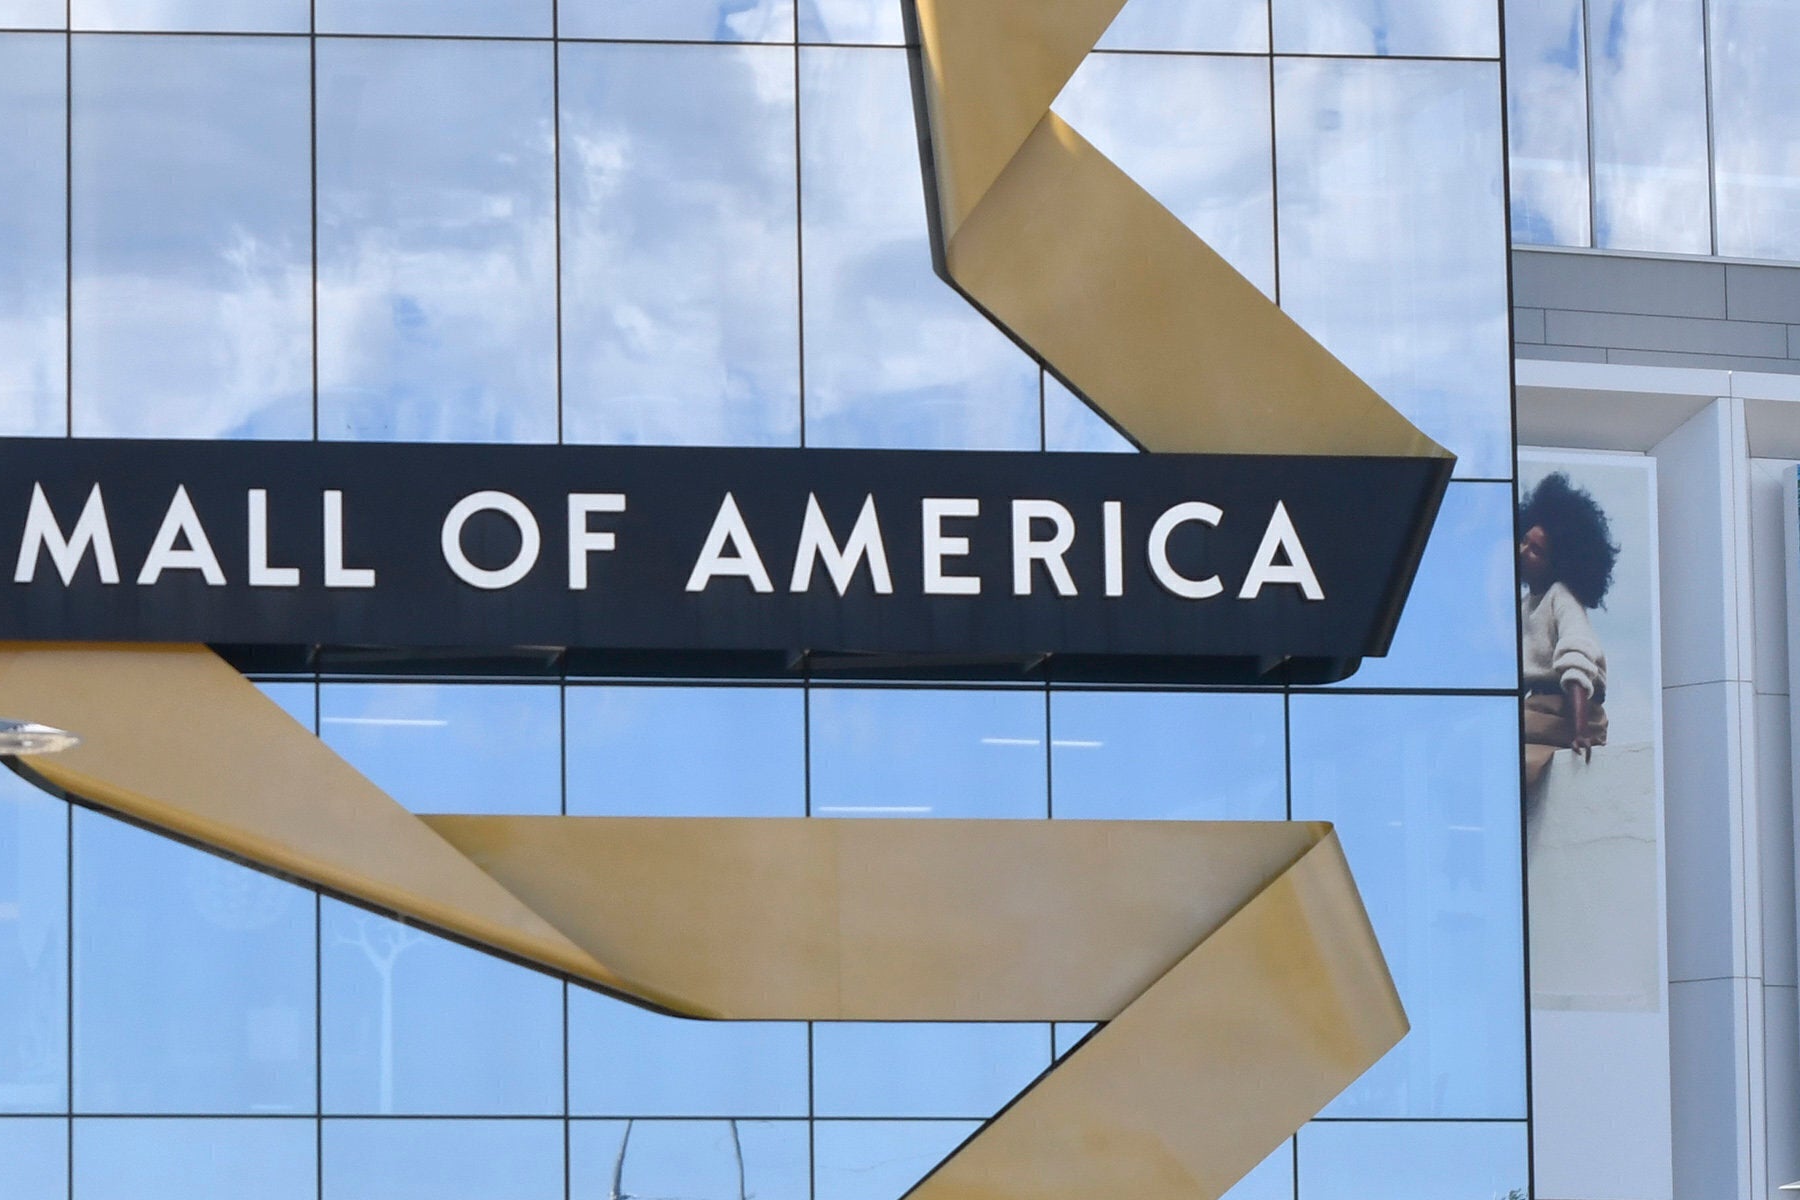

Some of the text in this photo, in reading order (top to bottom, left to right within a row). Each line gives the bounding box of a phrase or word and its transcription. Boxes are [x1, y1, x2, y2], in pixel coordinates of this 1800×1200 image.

[13, 481, 1327, 601] MALL OF AMERICA
